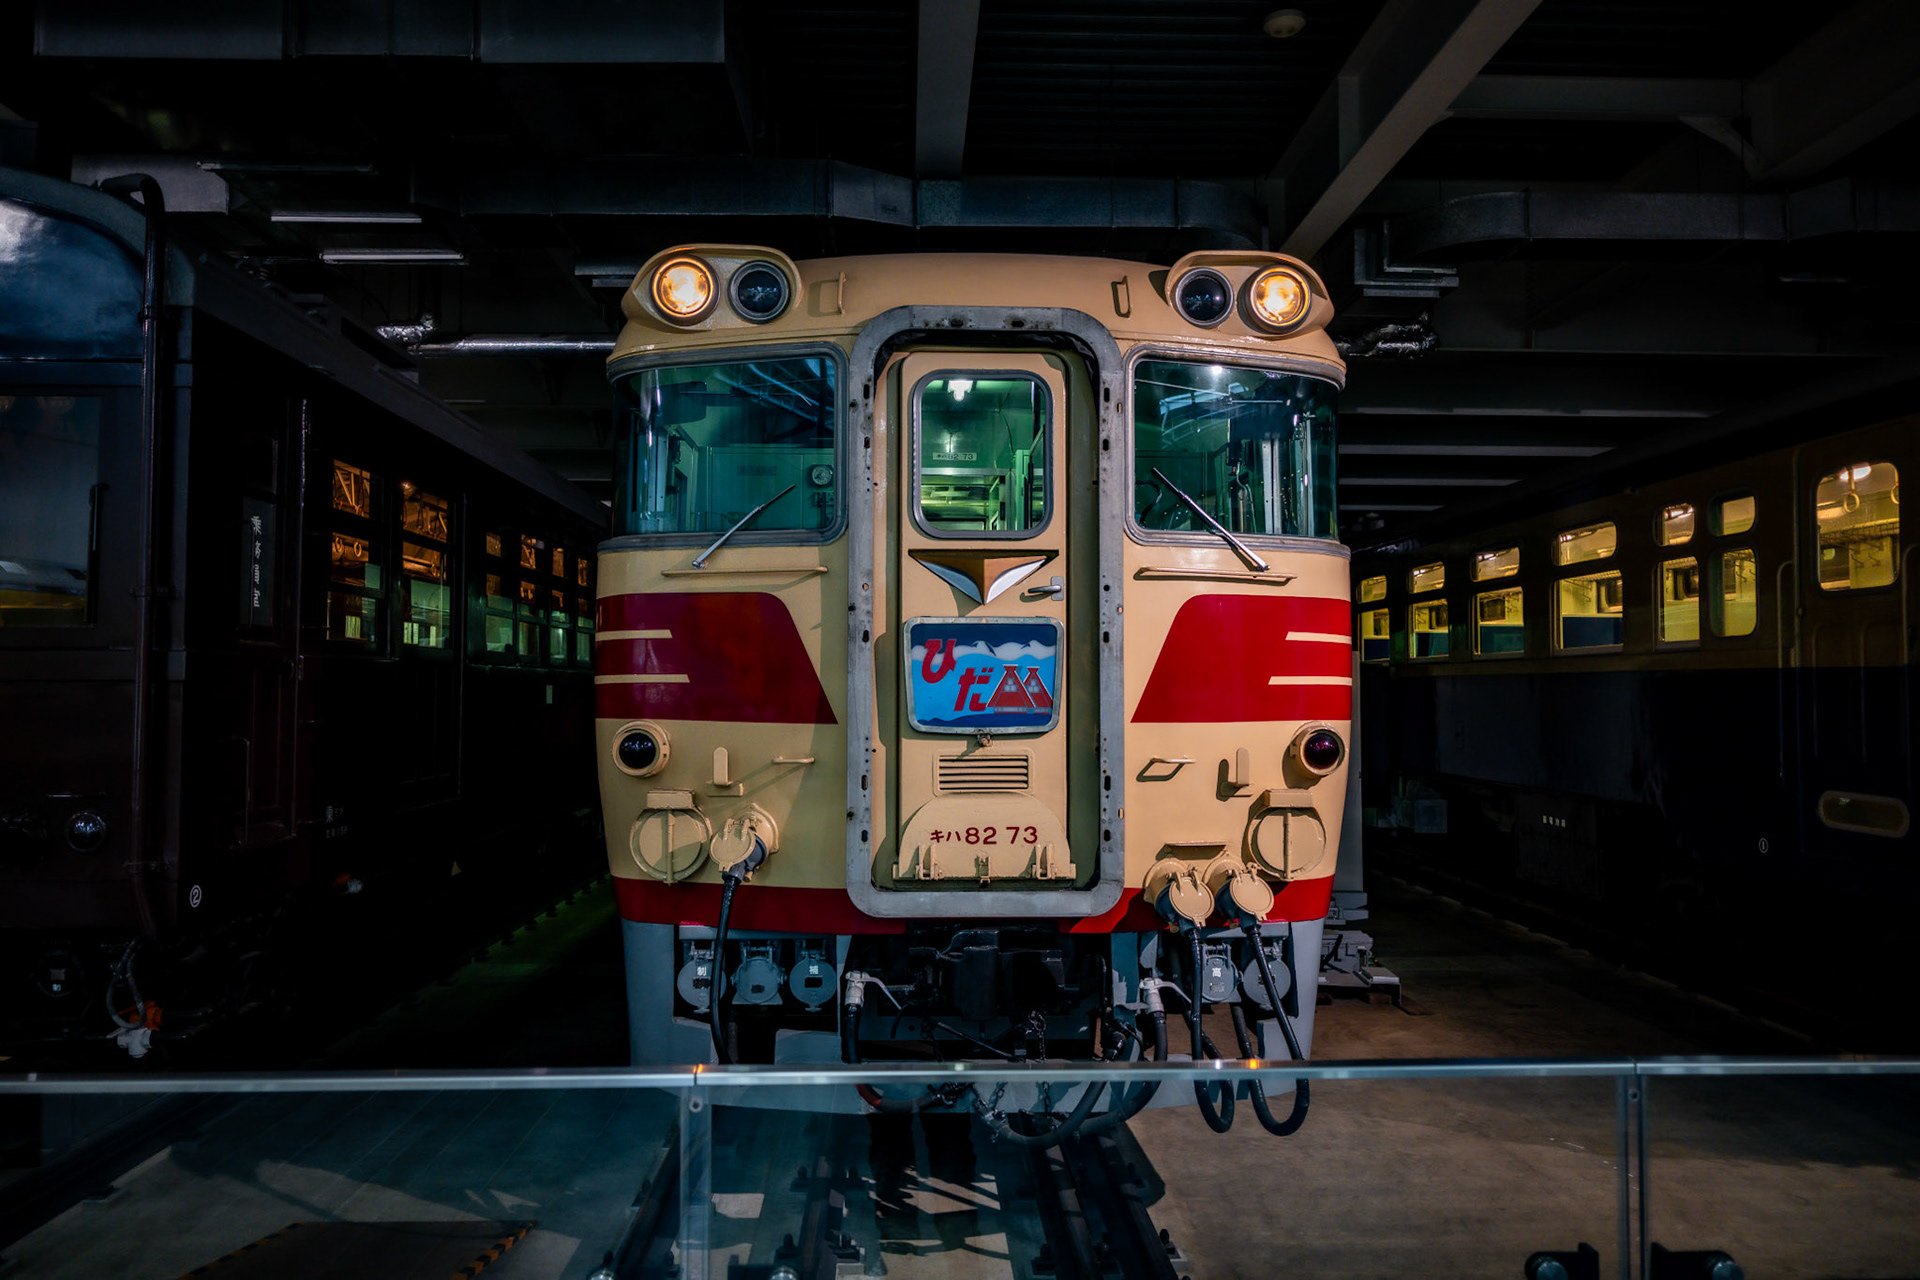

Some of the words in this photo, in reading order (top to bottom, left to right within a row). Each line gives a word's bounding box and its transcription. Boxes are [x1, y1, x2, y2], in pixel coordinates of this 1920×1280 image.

[921, 638, 995, 712] ひだ
[930, 826, 998, 845] キハ82
[1006, 826, 1038, 845] 73
